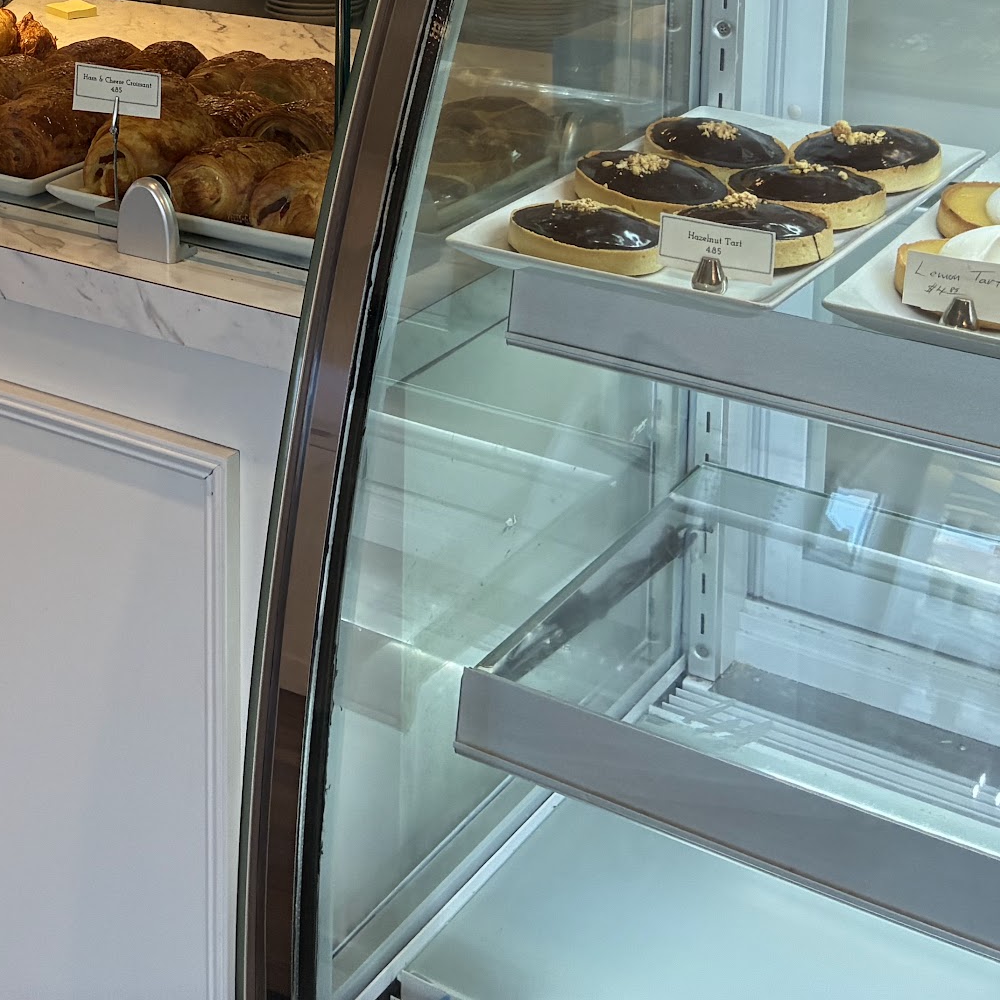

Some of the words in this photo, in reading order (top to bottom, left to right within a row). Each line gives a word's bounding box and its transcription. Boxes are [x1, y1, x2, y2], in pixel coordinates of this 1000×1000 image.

[83, 73, 97, 81] Ham
[105, 76, 124, 85] Cheese
[126, 80, 152, 89] Croissant
[688, 231, 722, 245] Hazelnut
[724, 238, 742, 247] Tart
[914, 260, 960, 281] Lemon
